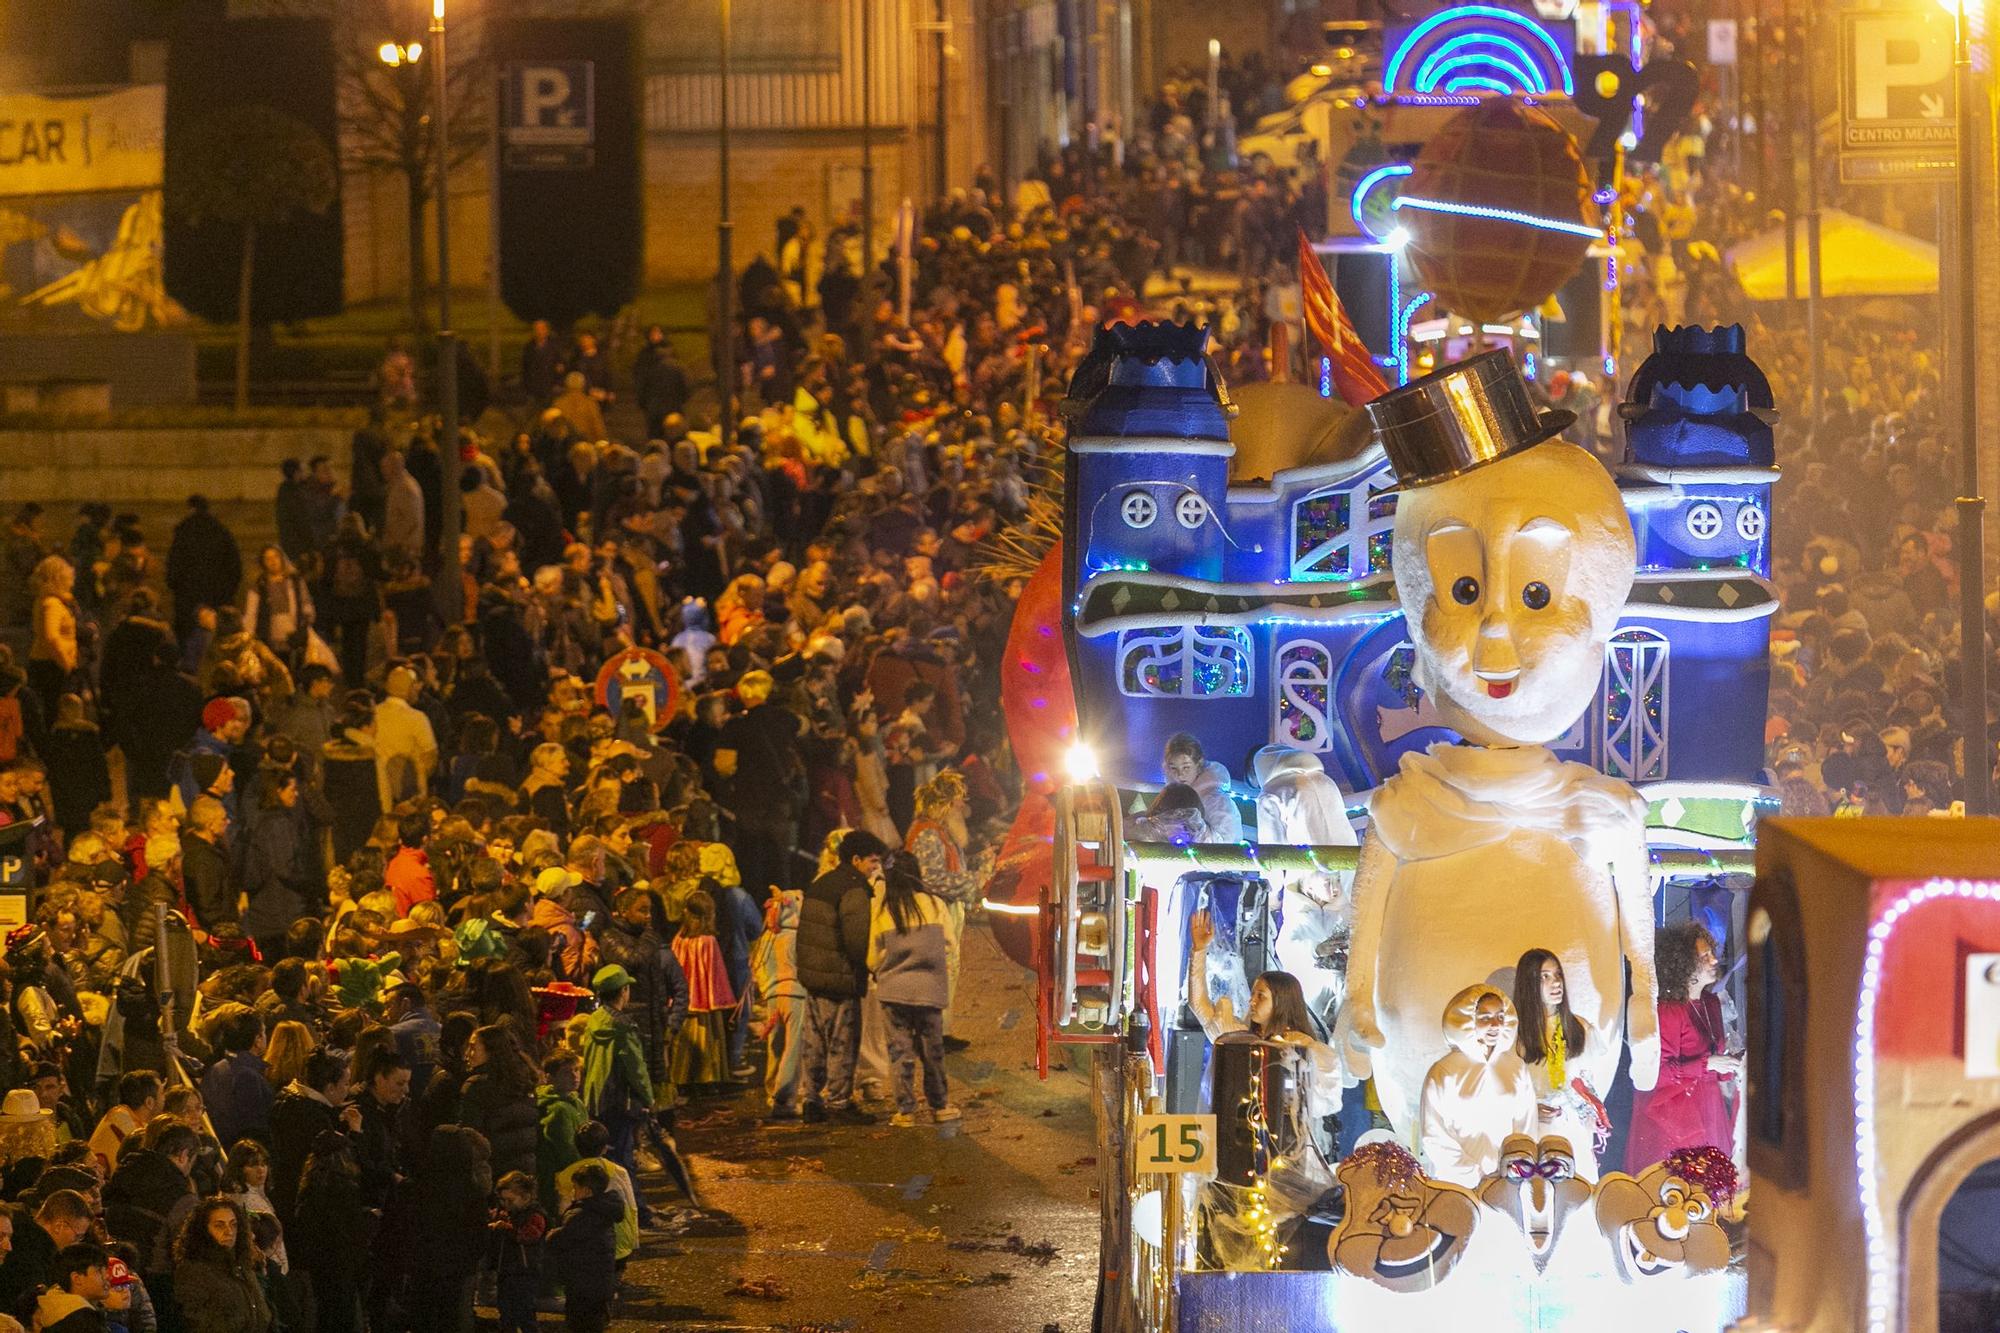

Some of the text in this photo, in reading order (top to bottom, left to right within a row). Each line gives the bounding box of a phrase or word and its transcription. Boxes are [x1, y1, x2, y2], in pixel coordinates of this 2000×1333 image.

[1856, 20, 1950, 119] P
[523, 67, 570, 126] P
[1849, 128, 1902, 141] CENTRO
[3, 855, 22, 882] P
[1150, 1124, 1204, 1163] 15
